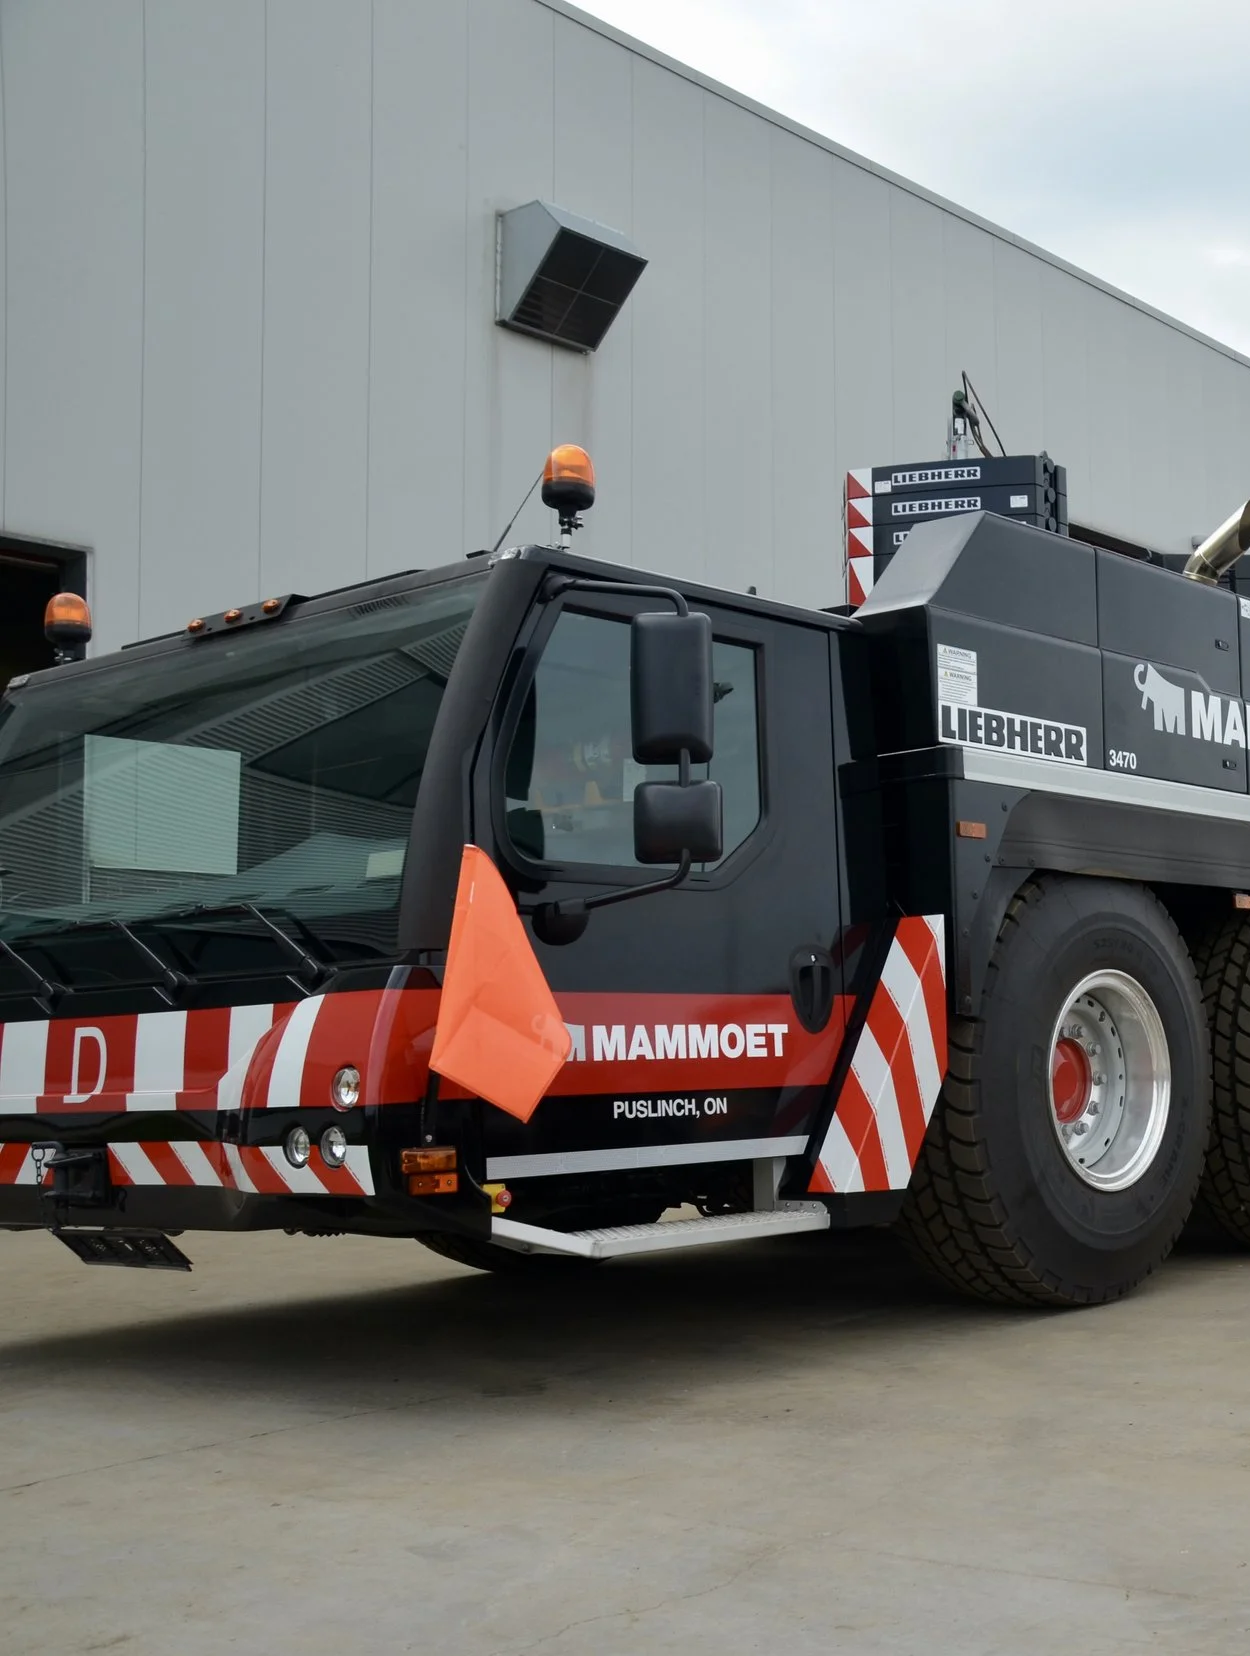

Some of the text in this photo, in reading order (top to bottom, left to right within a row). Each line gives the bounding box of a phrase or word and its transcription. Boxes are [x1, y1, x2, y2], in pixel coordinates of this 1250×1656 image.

[893, 468, 979, 484] LIEBHERR
[893, 498, 979, 514] LIEBHERR
[941, 704, 1084, 762] LIEBHERR
[1109, 749, 1137, 770] 3470
[592, 1023, 789, 1062] MAMMOET
[63, 1027, 107, 1104] D
[613, 1097, 728, 1119] PUSLINCH, ON
